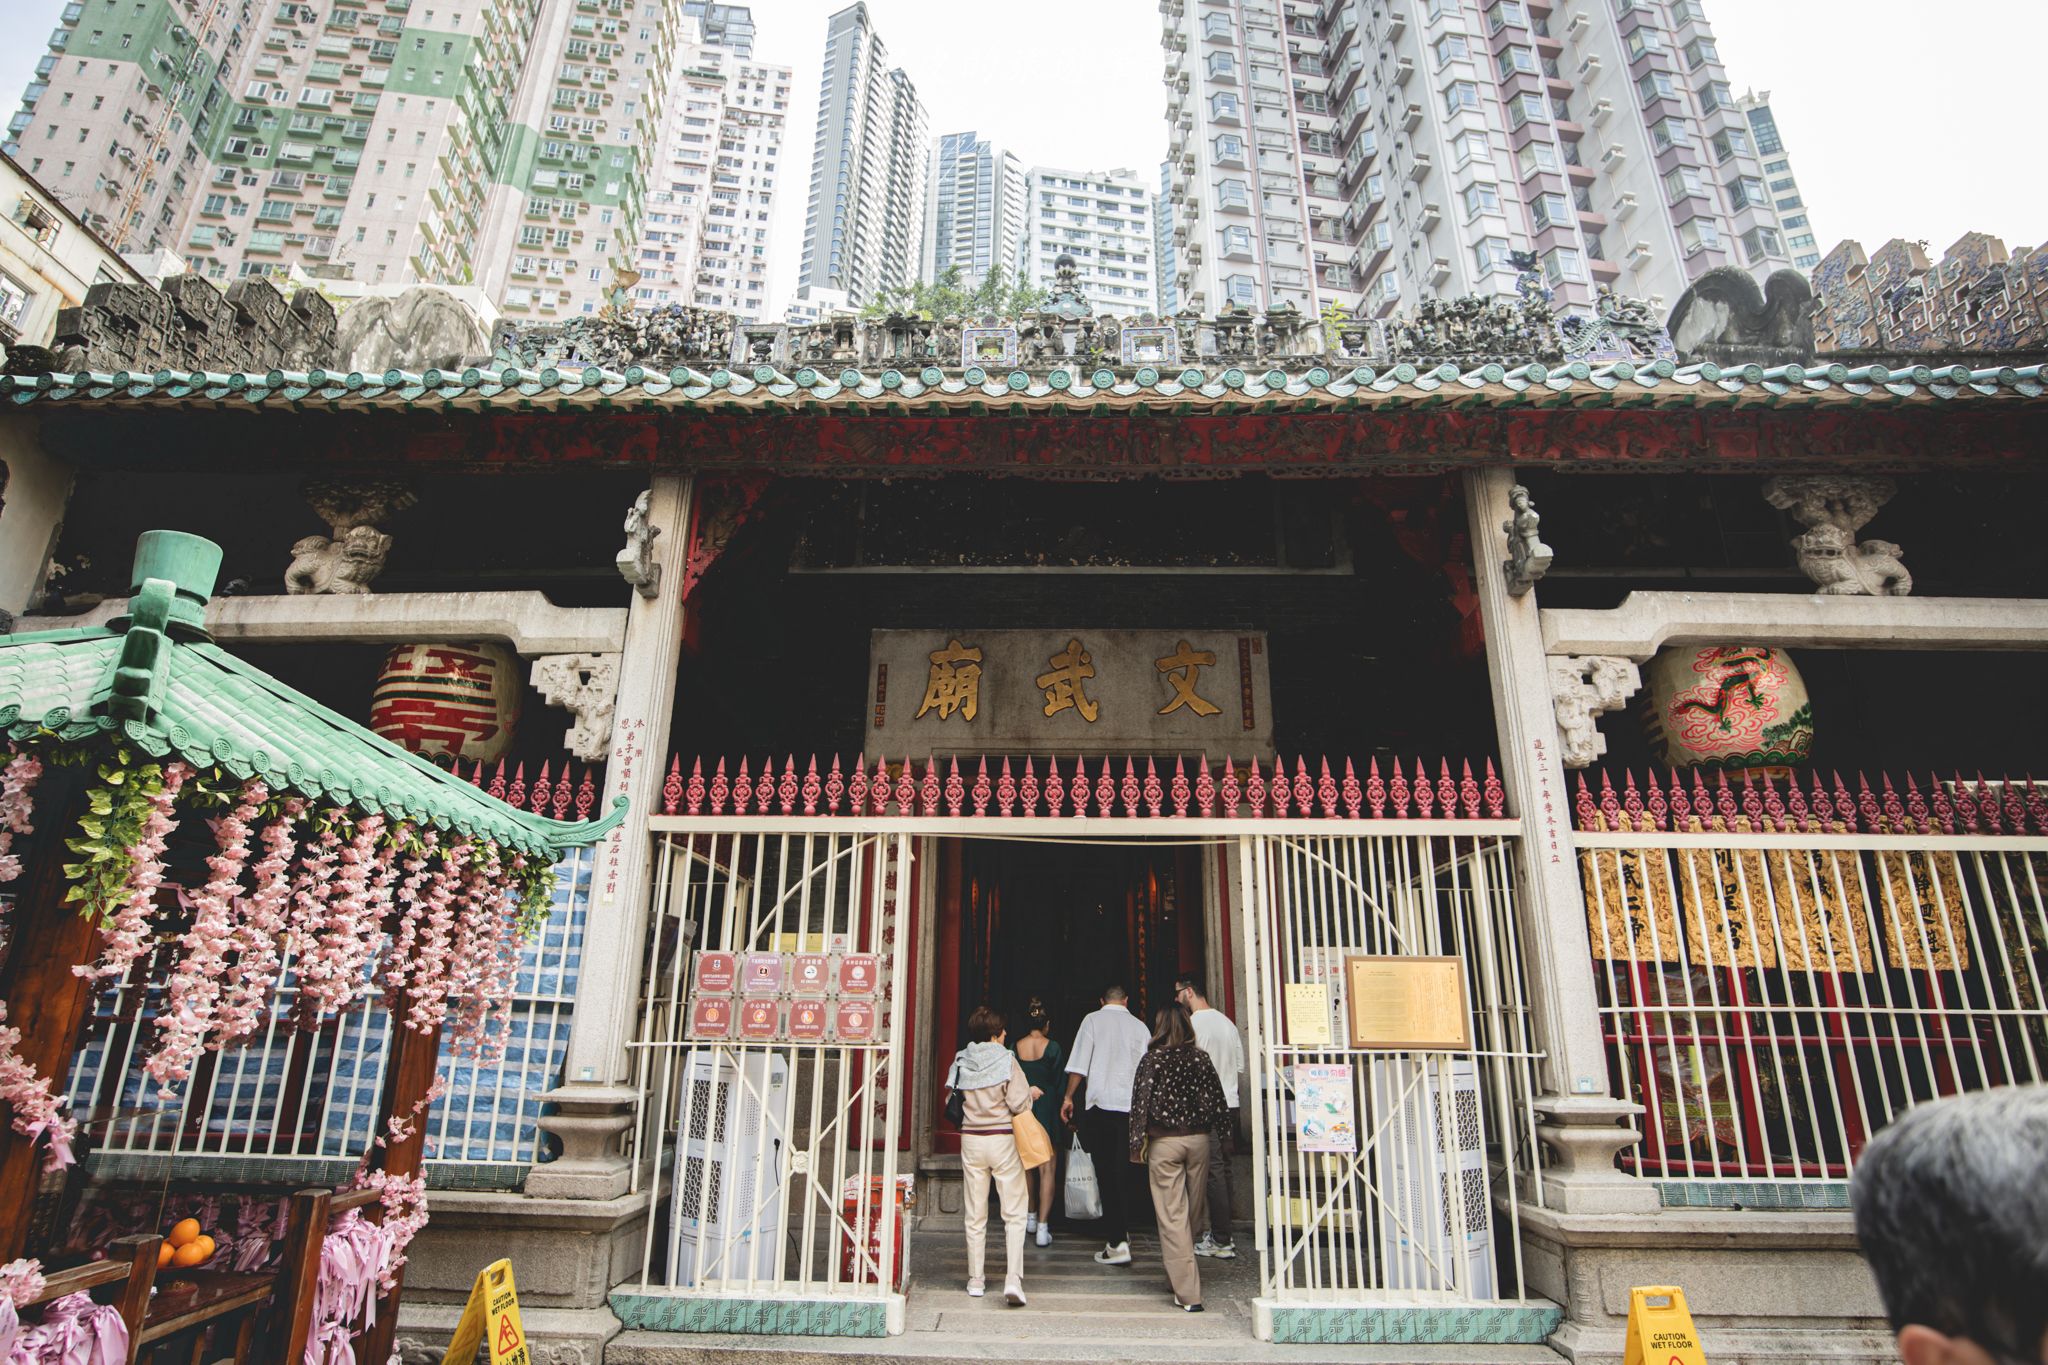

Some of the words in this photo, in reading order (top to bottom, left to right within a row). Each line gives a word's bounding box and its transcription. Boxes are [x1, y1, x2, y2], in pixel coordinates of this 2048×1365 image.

[915, 639, 1223, 723] 文武廟
[493, 1291, 511, 1306] CAUTION
[491, 1306, 500, 1316] WET
[500, 1298, 515, 1311] FLOOR
[1653, 1333, 1686, 1341] CAUTION
[1651, 1341, 1666, 1349] WET
[1667, 1341, 1693, 1349] FLOOR
